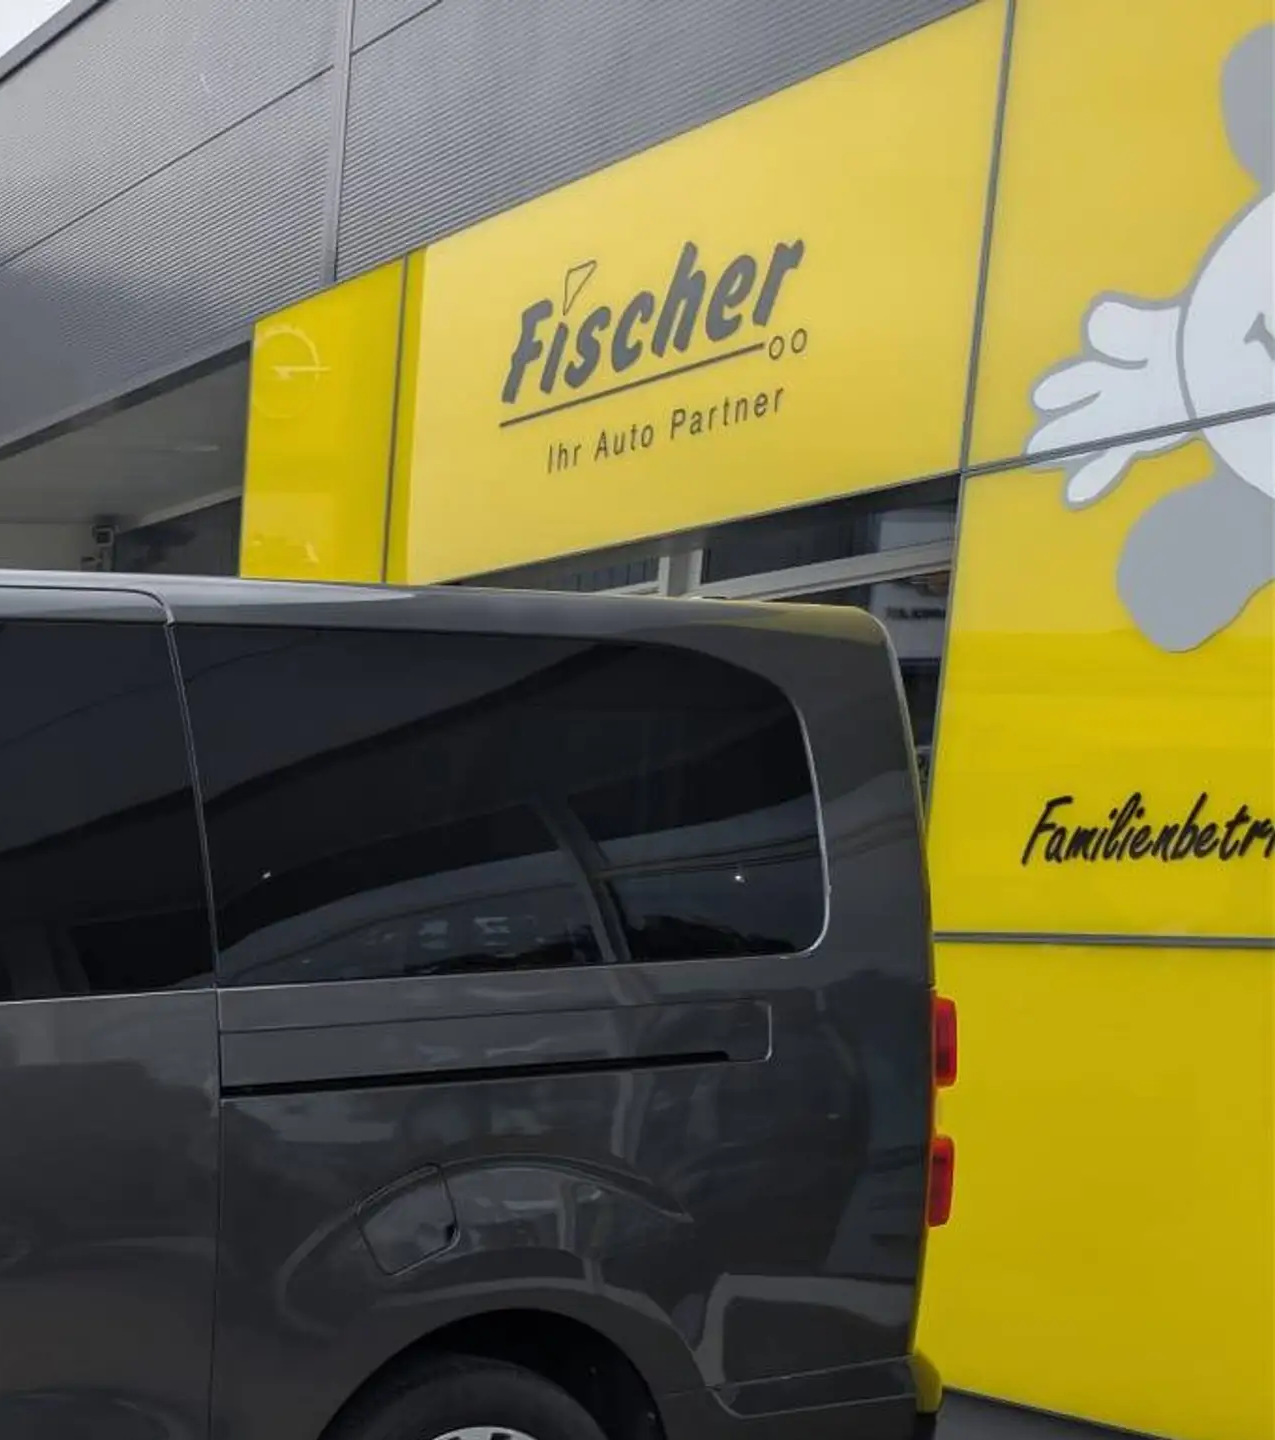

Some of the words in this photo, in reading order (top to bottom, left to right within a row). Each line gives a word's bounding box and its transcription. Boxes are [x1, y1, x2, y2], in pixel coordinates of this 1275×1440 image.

[502, 239, 804, 403] Fischer
[547, 440, 581, 474] Ihr
[594, 424, 654, 462] Auto
[670, 386, 785, 440] Partner
